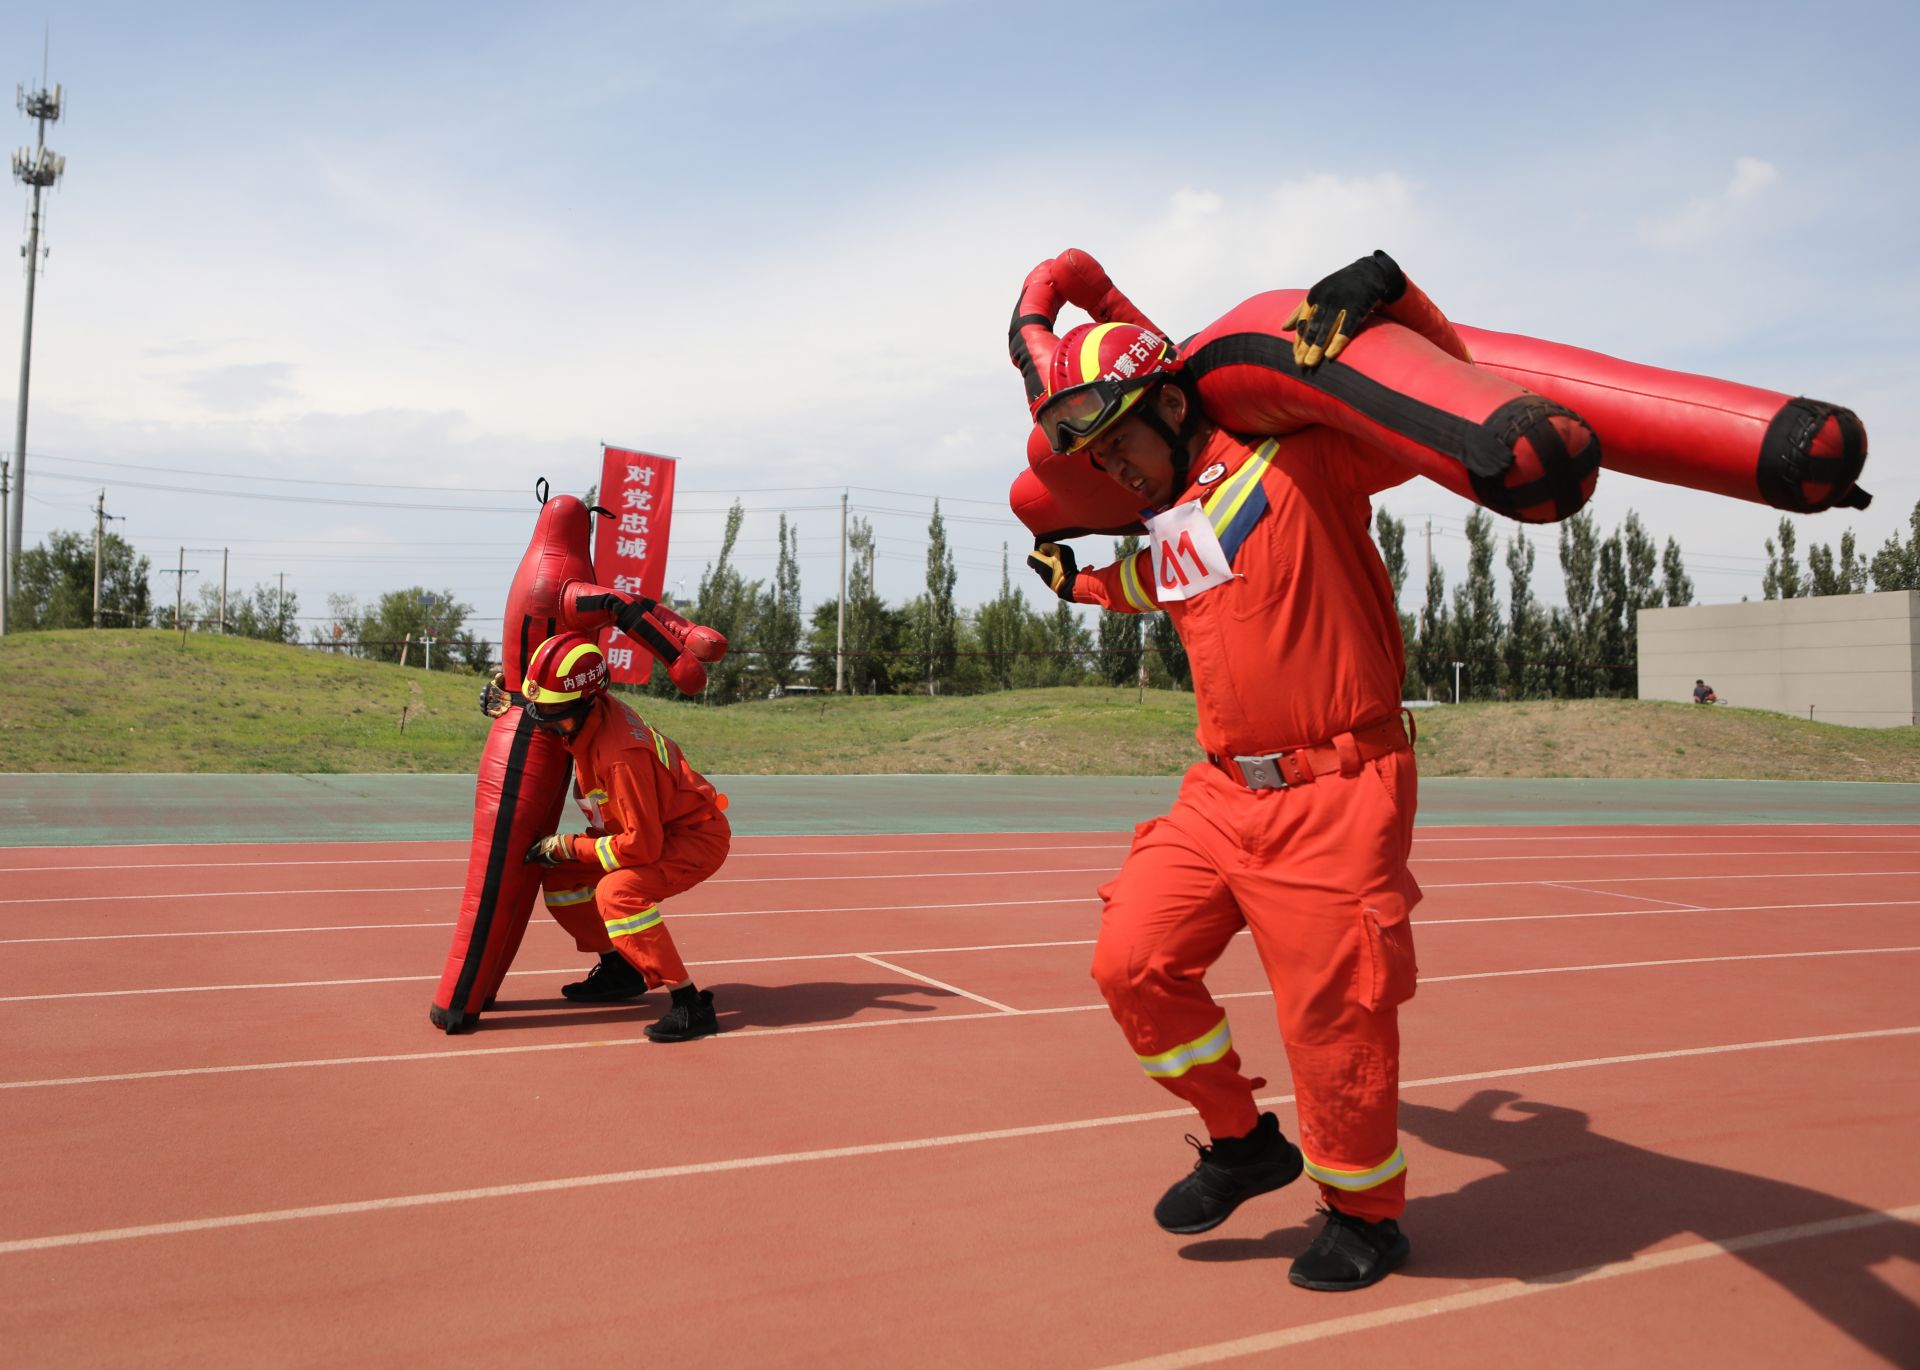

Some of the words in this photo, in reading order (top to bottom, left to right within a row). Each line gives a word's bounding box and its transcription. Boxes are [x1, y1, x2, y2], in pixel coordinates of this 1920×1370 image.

[616, 465, 656, 560] 对党忠诚
[1160, 530, 1209, 589] 41
